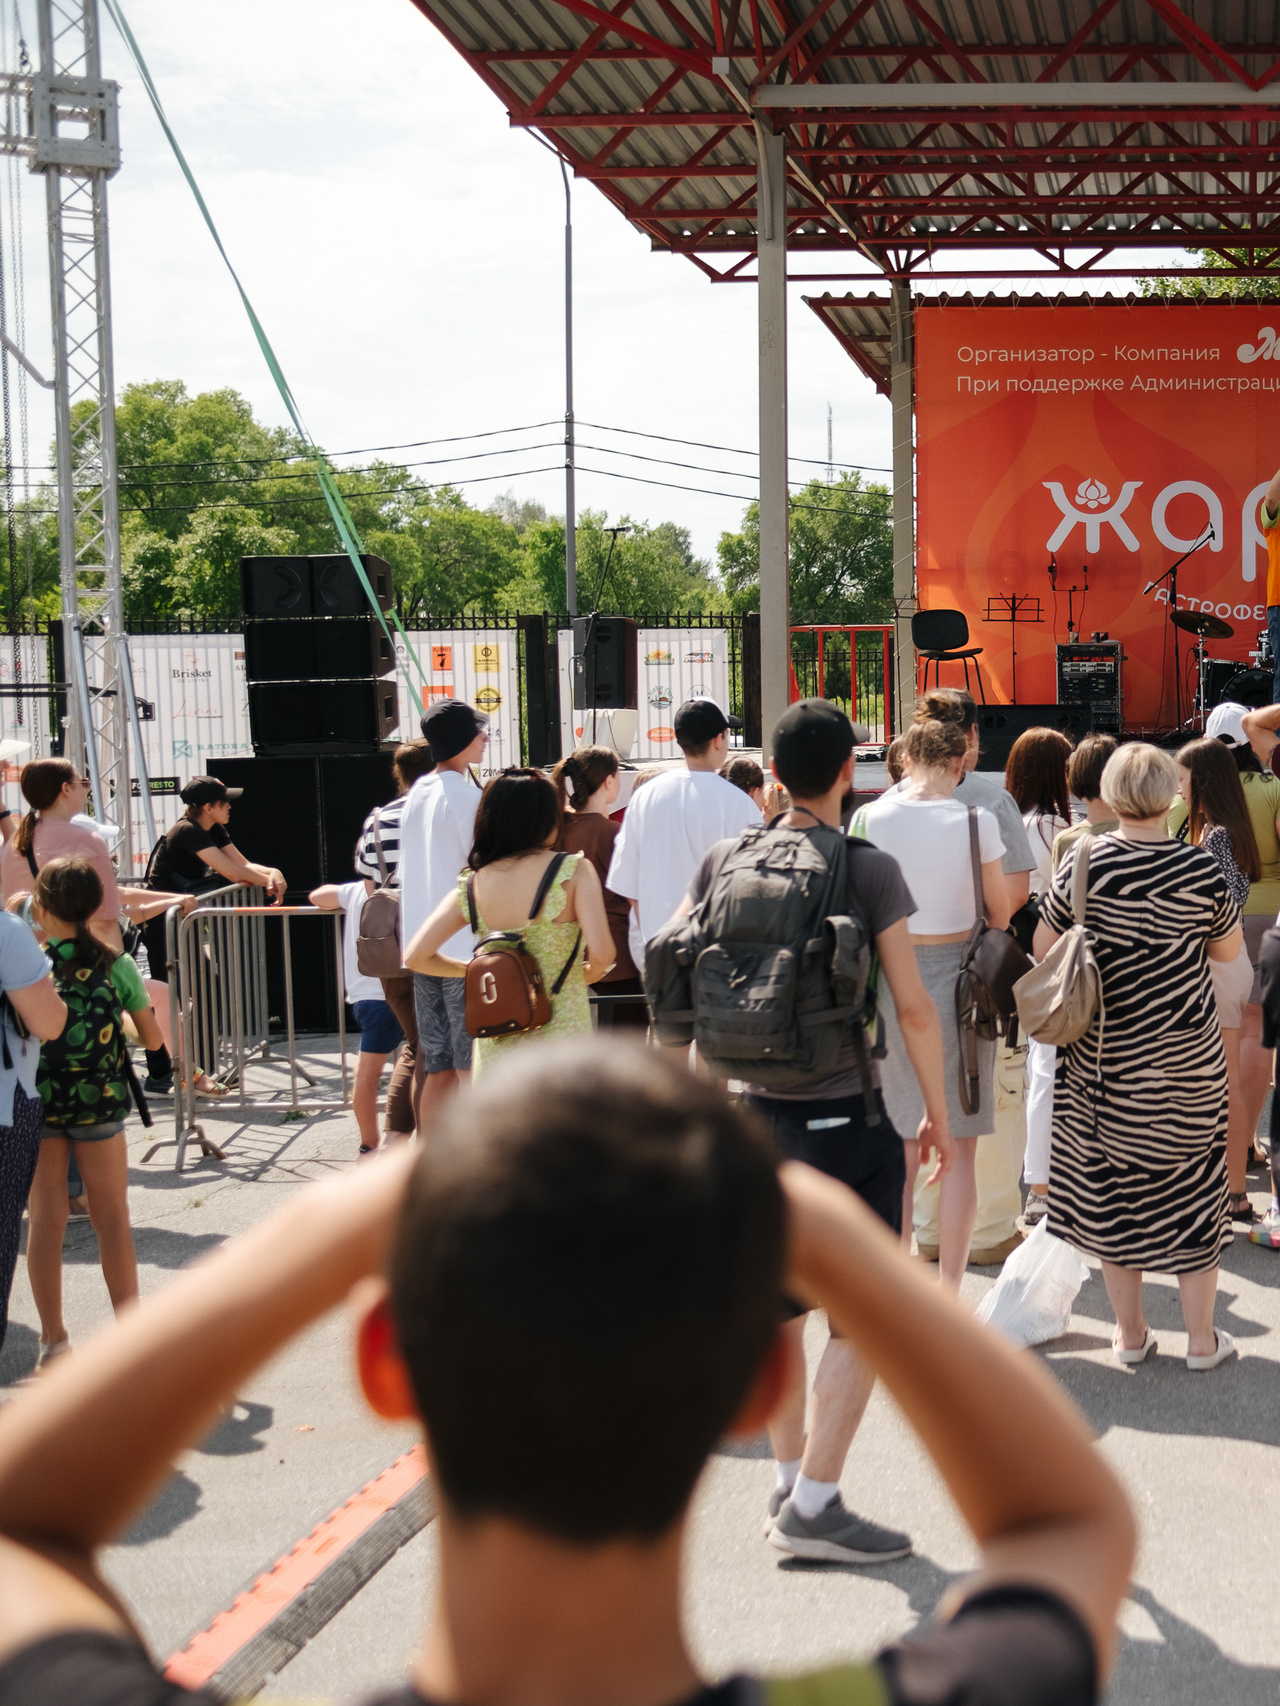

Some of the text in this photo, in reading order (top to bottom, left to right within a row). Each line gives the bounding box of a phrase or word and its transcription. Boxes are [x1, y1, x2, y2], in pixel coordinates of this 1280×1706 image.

[957, 346, 1095, 366] Организатор
[1114, 345, 1220, 361] Компания
[957, 376, 1000, 396] При
[1006, 377, 1124, 395] поддержке
[172, 668, 212, 679] Brisket
